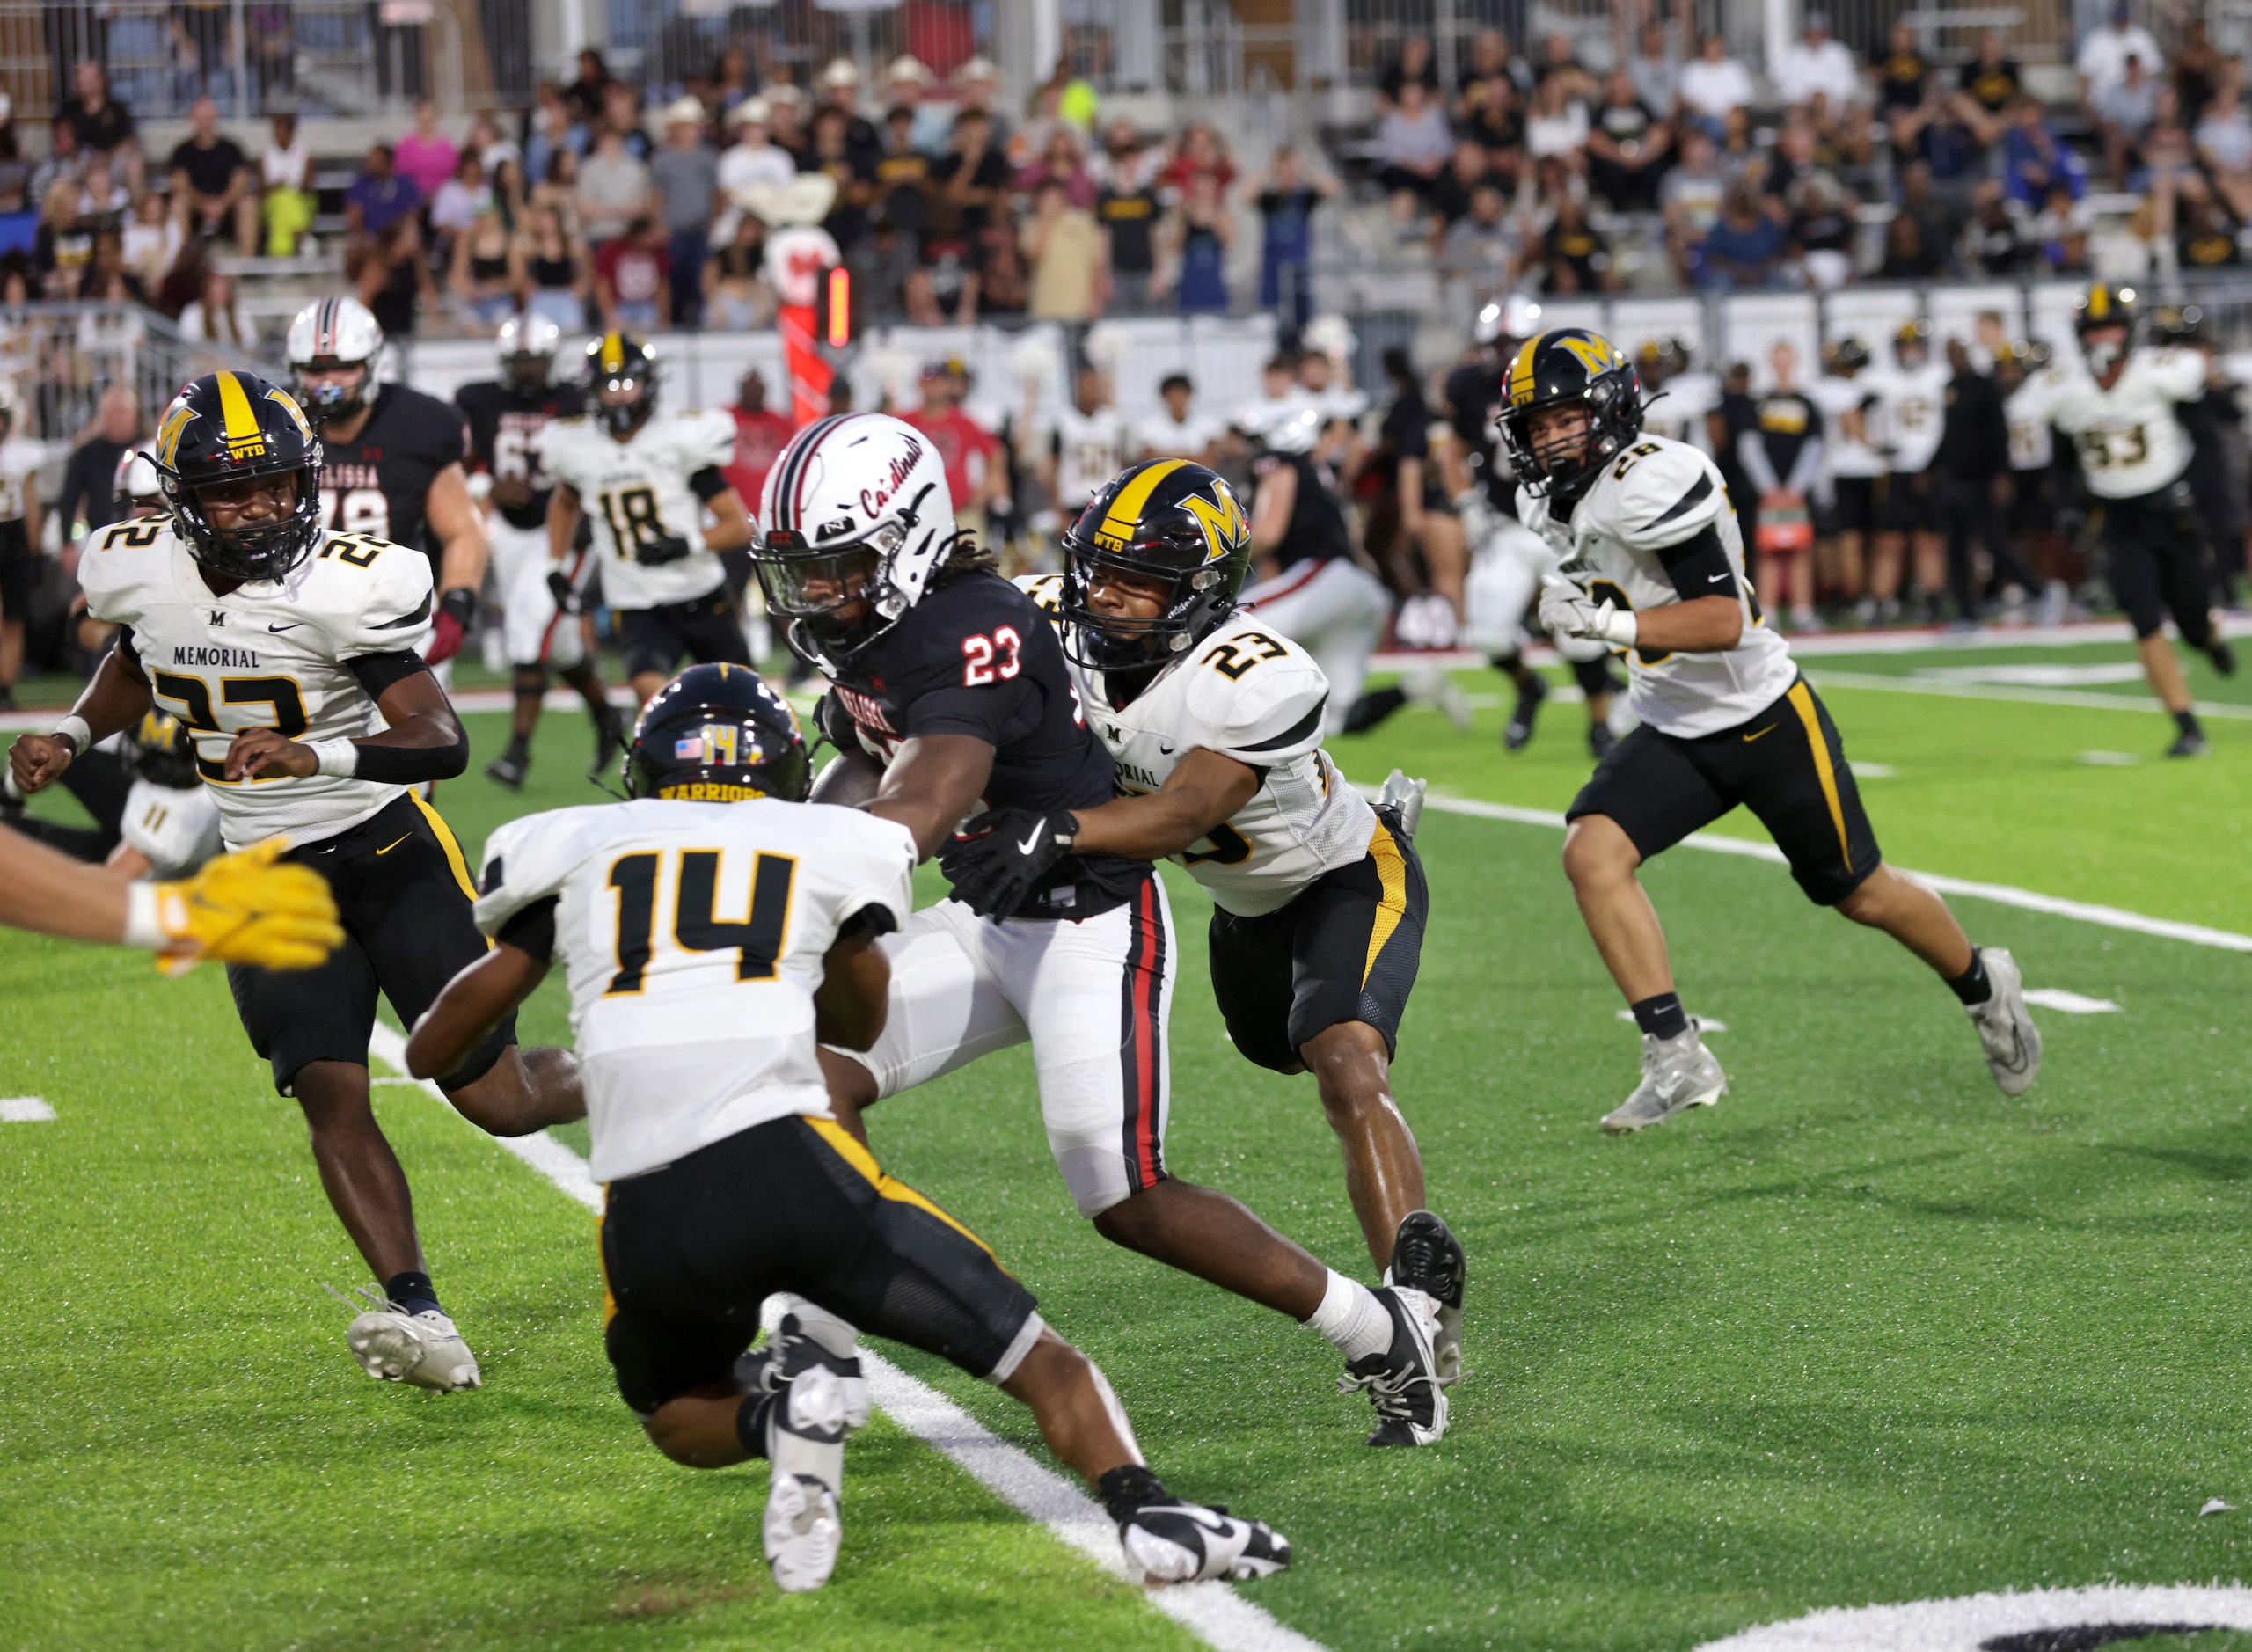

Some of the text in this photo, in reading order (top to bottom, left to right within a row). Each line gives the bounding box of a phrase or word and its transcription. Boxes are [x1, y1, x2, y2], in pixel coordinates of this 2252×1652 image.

[1549, 332, 1626, 384] M
[230, 444, 266, 461] WTB
[318, 463, 380, 488] LISSA
[598, 487, 670, 560] 18
[1093, 531, 1123, 552] WTB
[1174, 477, 1250, 566] M
[208, 610, 226, 627] M
[173, 647, 260, 668] MEMORIAL
[962, 624, 1021, 688] 23
[1199, 632, 1290, 683] 23
[140, 712, 179, 752] M
[702, 724, 738, 766] 14
[1106, 723, 1122, 744] M
[1116, 762, 1159, 787] ORIAL
[602, 847, 800, 999] 14
